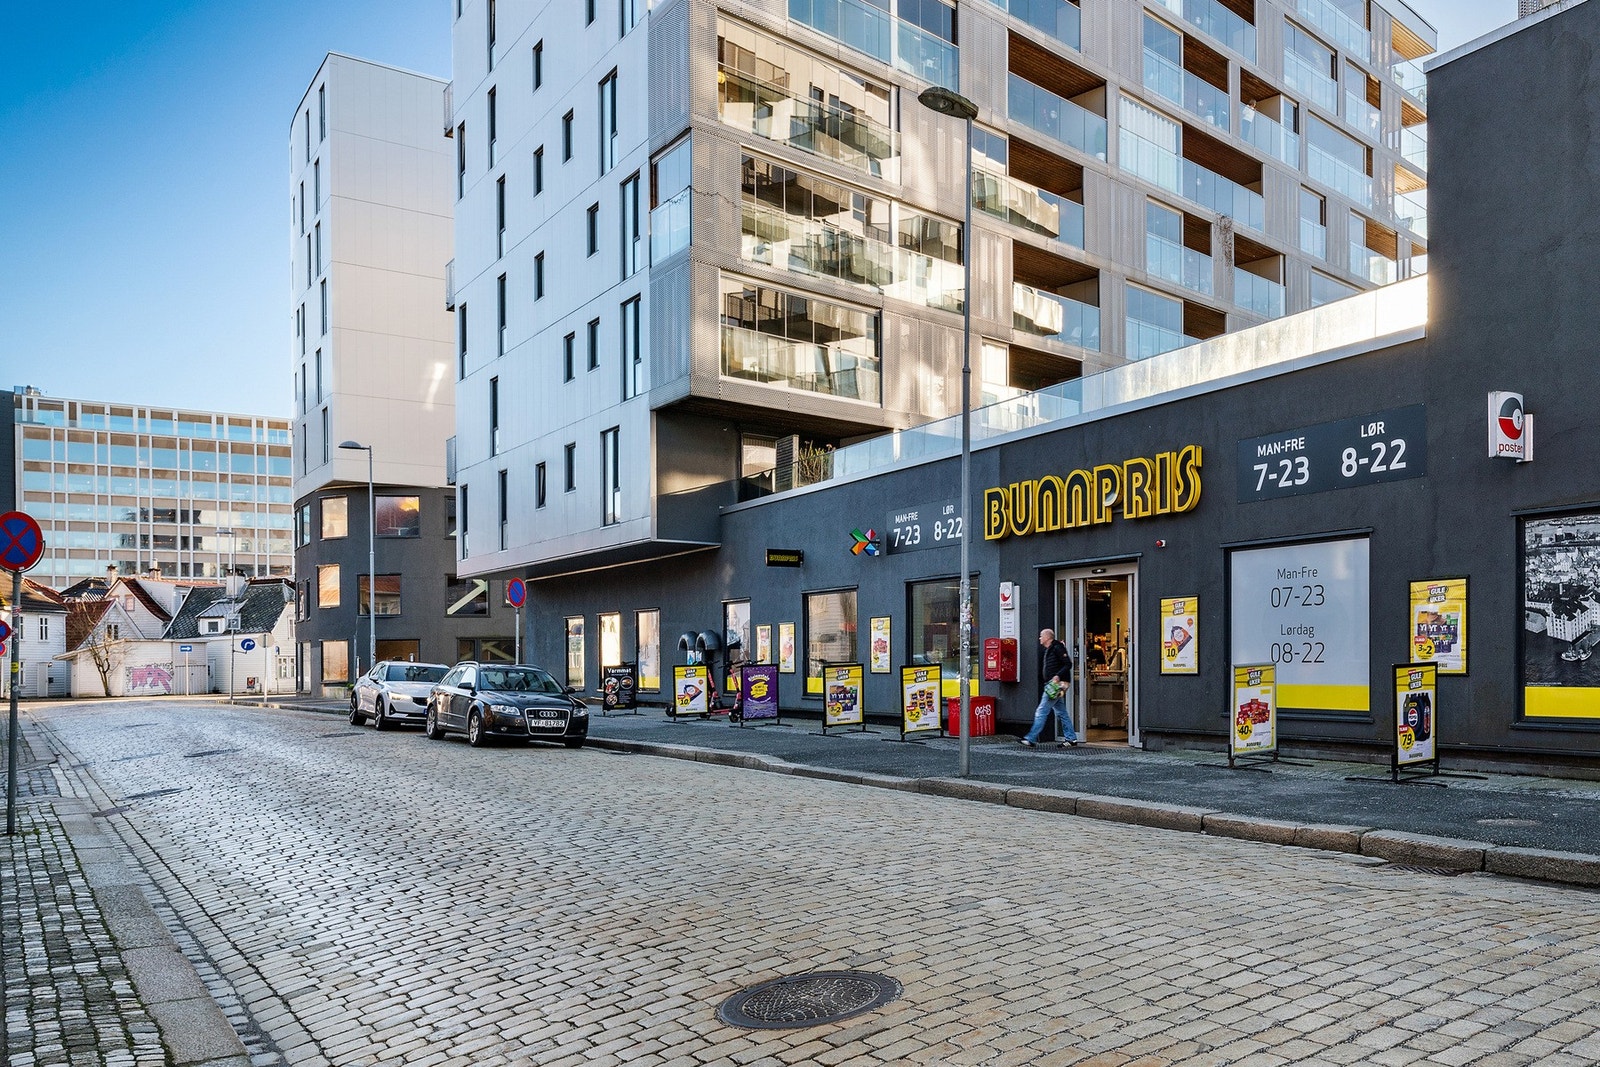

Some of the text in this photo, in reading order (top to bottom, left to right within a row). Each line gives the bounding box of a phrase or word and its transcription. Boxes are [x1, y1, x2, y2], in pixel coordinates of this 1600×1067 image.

[1360, 421, 1385, 438] LØR
[1257, 437, 1305, 457] MAN-FRE
[1253, 438, 1407, 492] 7-23 8-22
[984, 444, 1202, 541] BUNNPRIS
[895, 511, 919, 524] MAN-FRE
[942, 504, 955, 515] LØR
[893, 517, 964, 548] 7-23 8-22
[1277, 566, 1318, 579] Man-Fre
[1270, 584, 1325, 608] 07-23
[1430, 587, 1446, 596] GULE
[1280, 623, 1315, 639] Lørdag
[1270, 642, 1325, 664] 08-22
